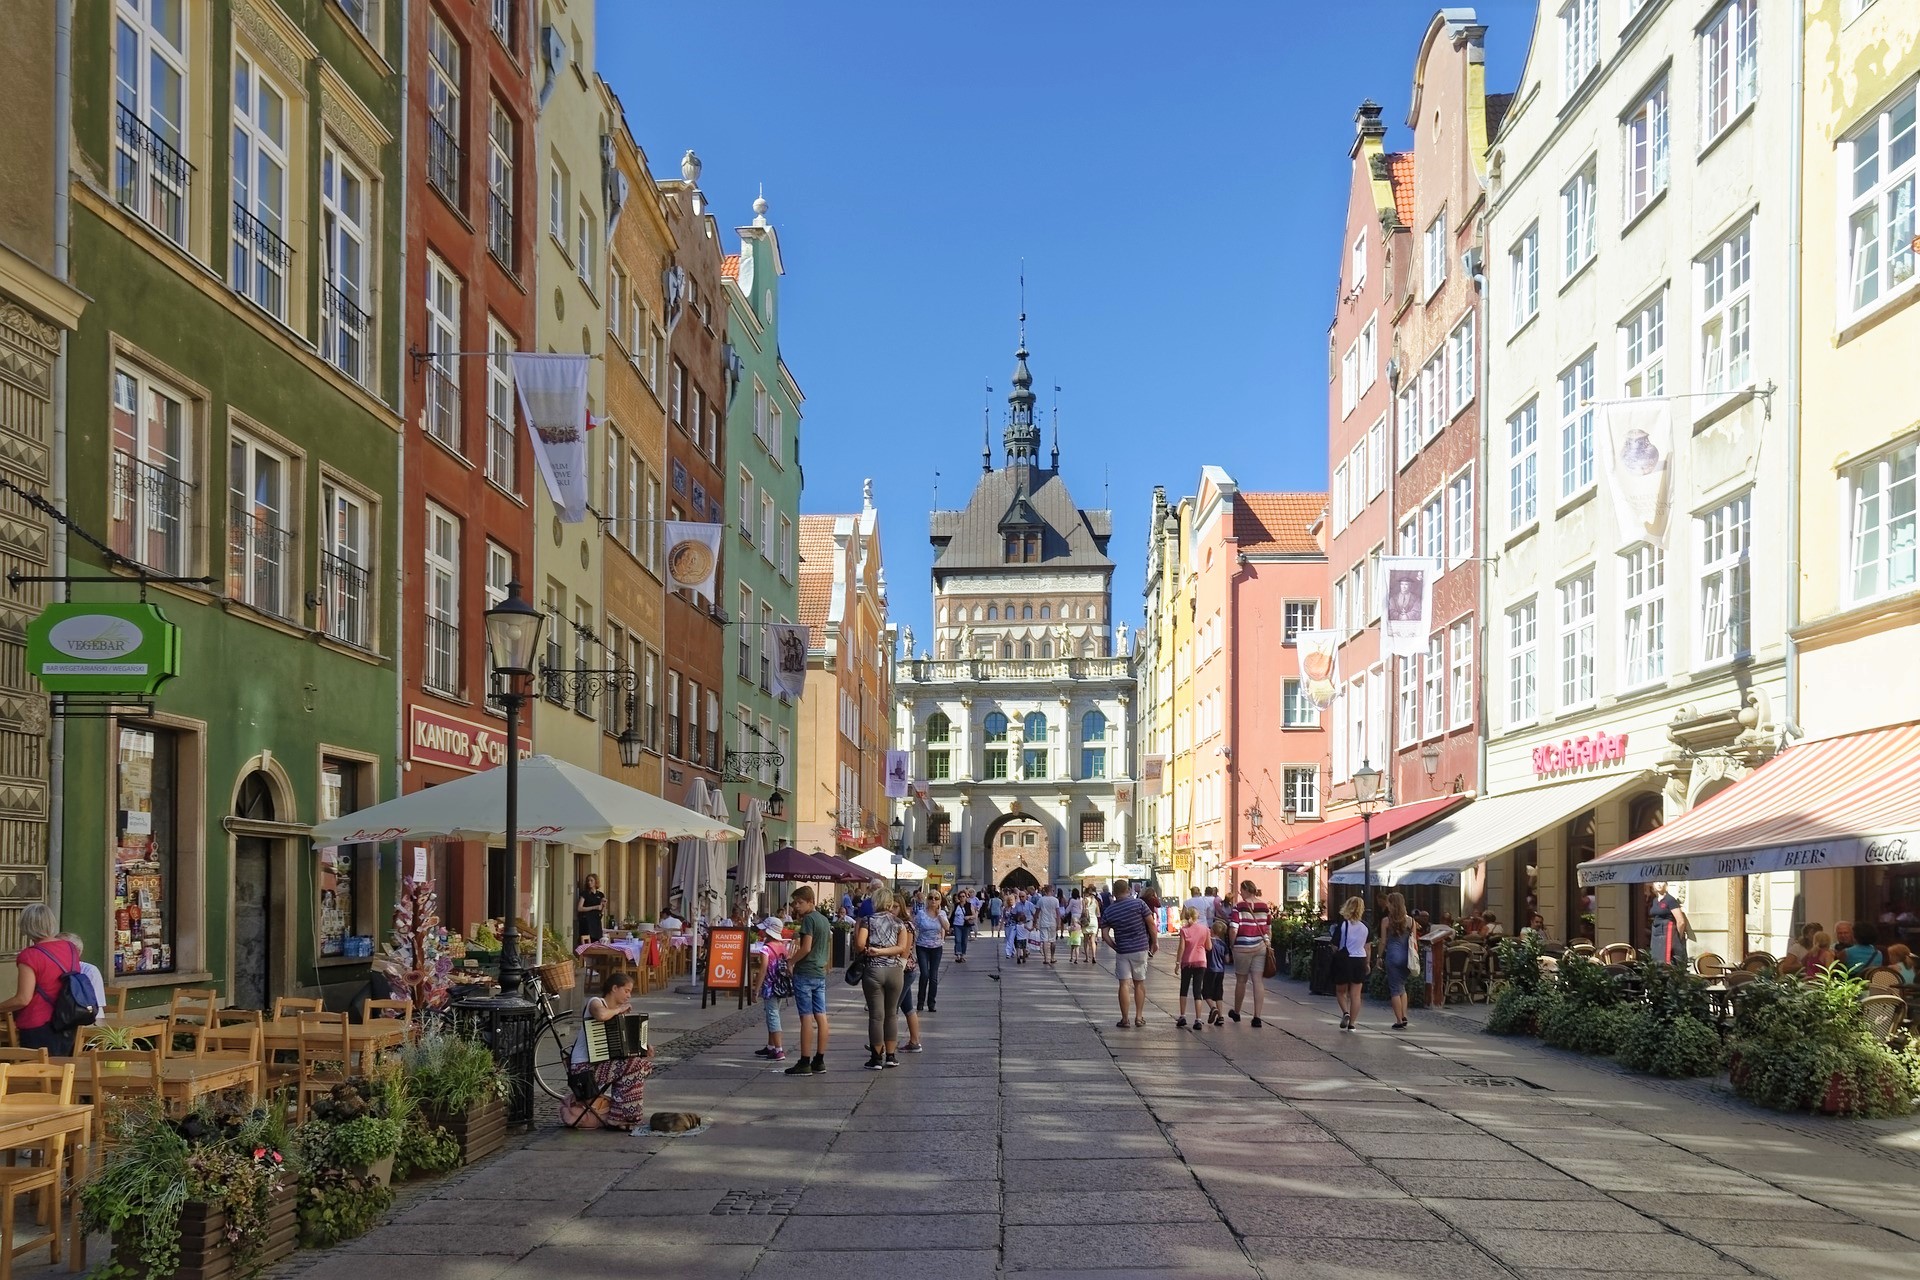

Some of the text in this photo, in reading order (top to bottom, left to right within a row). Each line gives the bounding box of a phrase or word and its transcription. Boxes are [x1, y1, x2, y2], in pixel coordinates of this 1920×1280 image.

[67, 640, 125, 651] VEGEBAR
[415, 721, 470, 757] KANTOR
[1717, 857, 1756, 874] DRINKS
[1784, 848, 1827, 866] BEERS
[1639, 862, 1691, 877] COCKTAILS
